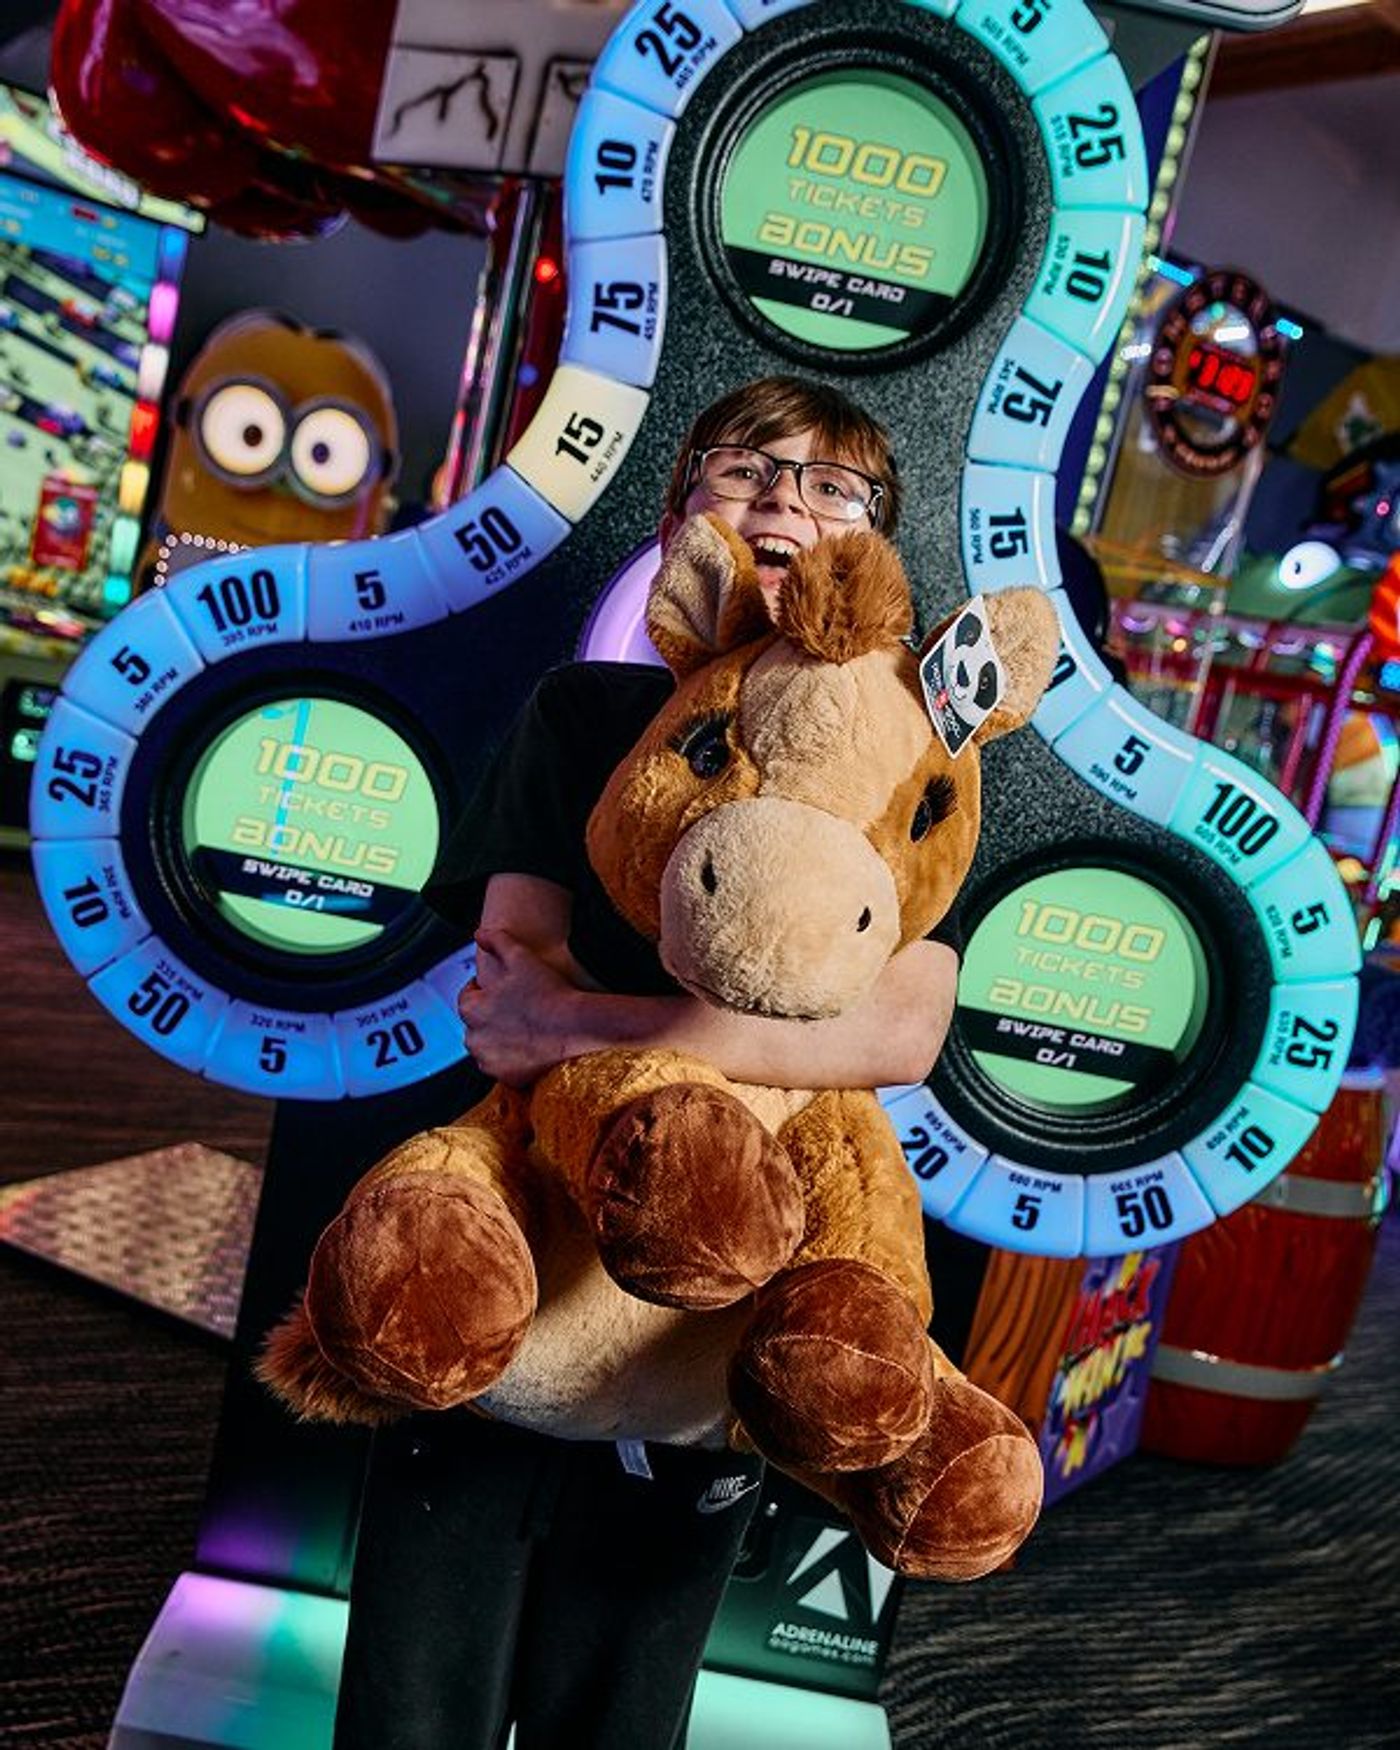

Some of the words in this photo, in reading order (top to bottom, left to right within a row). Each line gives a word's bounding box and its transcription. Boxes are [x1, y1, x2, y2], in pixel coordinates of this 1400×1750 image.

[1011, 0, 1052, 33] 5
[634, 2, 702, 77] 25
[691, 37, 717, 66] RPM
[1068, 104, 1126, 168] 25
[595, 140, 637, 196] 10
[645, 140, 660, 174] RPM
[788, 127, 949, 198] 1000
[1058, 142, 1074, 178] RPM
[788, 178, 927, 229] TICKETS
[759, 212, 936, 279] BONUS
[768, 259, 842, 289] SWIPE
[846, 277, 906, 303] CARD
[1043, 262, 1063, 296] RPM
[1066, 250, 1111, 302] 10
[590, 281, 645, 337] 75
[646, 282, 658, 315] RPM
[811, 293, 853, 316] 0/1
[987, 381, 1005, 415] RPM
[1002, 366, 1063, 428] 75
[555, 412, 604, 466] 15
[590, 462, 609, 482] 440
[604, 431, 624, 460] RPM
[969, 508, 981, 530] 560
[989, 506, 1029, 559] 15
[454, 506, 523, 572] 50
[505, 546, 532, 571] RPM
[971, 533, 983, 565] RPM
[197, 570, 281, 632] 100
[354, 570, 387, 610] 5
[246, 623, 278, 637] RPM
[349, 617, 372, 632] 410
[375, 611, 404, 629] RPM
[110, 645, 151, 686] 5
[151, 667, 179, 695] RPM
[1046, 653, 1077, 694] 0
[103, 755, 118, 787] RPM
[257, 738, 408, 802] 1000
[1113, 735, 1151, 776] 5
[48, 746, 103, 808] 25
[1109, 778, 1138, 800] RPM
[259, 786, 391, 830] TICKETS
[1203, 783, 1279, 855] 100
[232, 817, 399, 874] BONUS
[1214, 838, 1241, 865] RPM
[242, 859, 312, 886] SWIPE
[317, 875, 374, 898] CARD
[64, 875, 110, 928] 10
[111, 890, 131, 920] RPM
[285, 889, 325, 911] 0/1
[1292, 902, 1331, 935] 5
[1017, 900, 1166, 962] 1000
[1274, 927, 1292, 959] RPM
[176, 976, 204, 1000] RPM
[1016, 948, 1146, 989] TICKETS
[128, 971, 190, 1036] 50
[380, 998, 408, 1018] RPM
[989, 978, 1152, 1033] BONUS
[275, 1017, 306, 1033] RPM
[366, 1019, 425, 1069] 20
[996, 1018, 1066, 1044] SWIPE
[1070, 1035, 1126, 1056] CARD
[1286, 1015, 1338, 1071] 25
[259, 1036, 287, 1075] 5
[1036, 1048, 1077, 1068] 0/1
[1268, 1034, 1287, 1066] RPM
[941, 1128, 967, 1154] RPM
[1206, 1131, 1227, 1150] 650
[1226, 1106, 1249, 1133] RPM
[901, 1126, 949, 1180] 20
[1223, 1124, 1276, 1173] 10
[1008, 1171, 1031, 1188] 680
[1032, 1177, 1062, 1193] RPM
[1110, 1179, 1133, 1194] 665
[1136, 1169, 1164, 1187] RPM
[1011, 1193, 1042, 1231] 5
[1115, 1185, 1174, 1238] 50
[709, 1475, 747, 1500] NIKE
[771, 1622, 879, 1656] ADRENALINE
